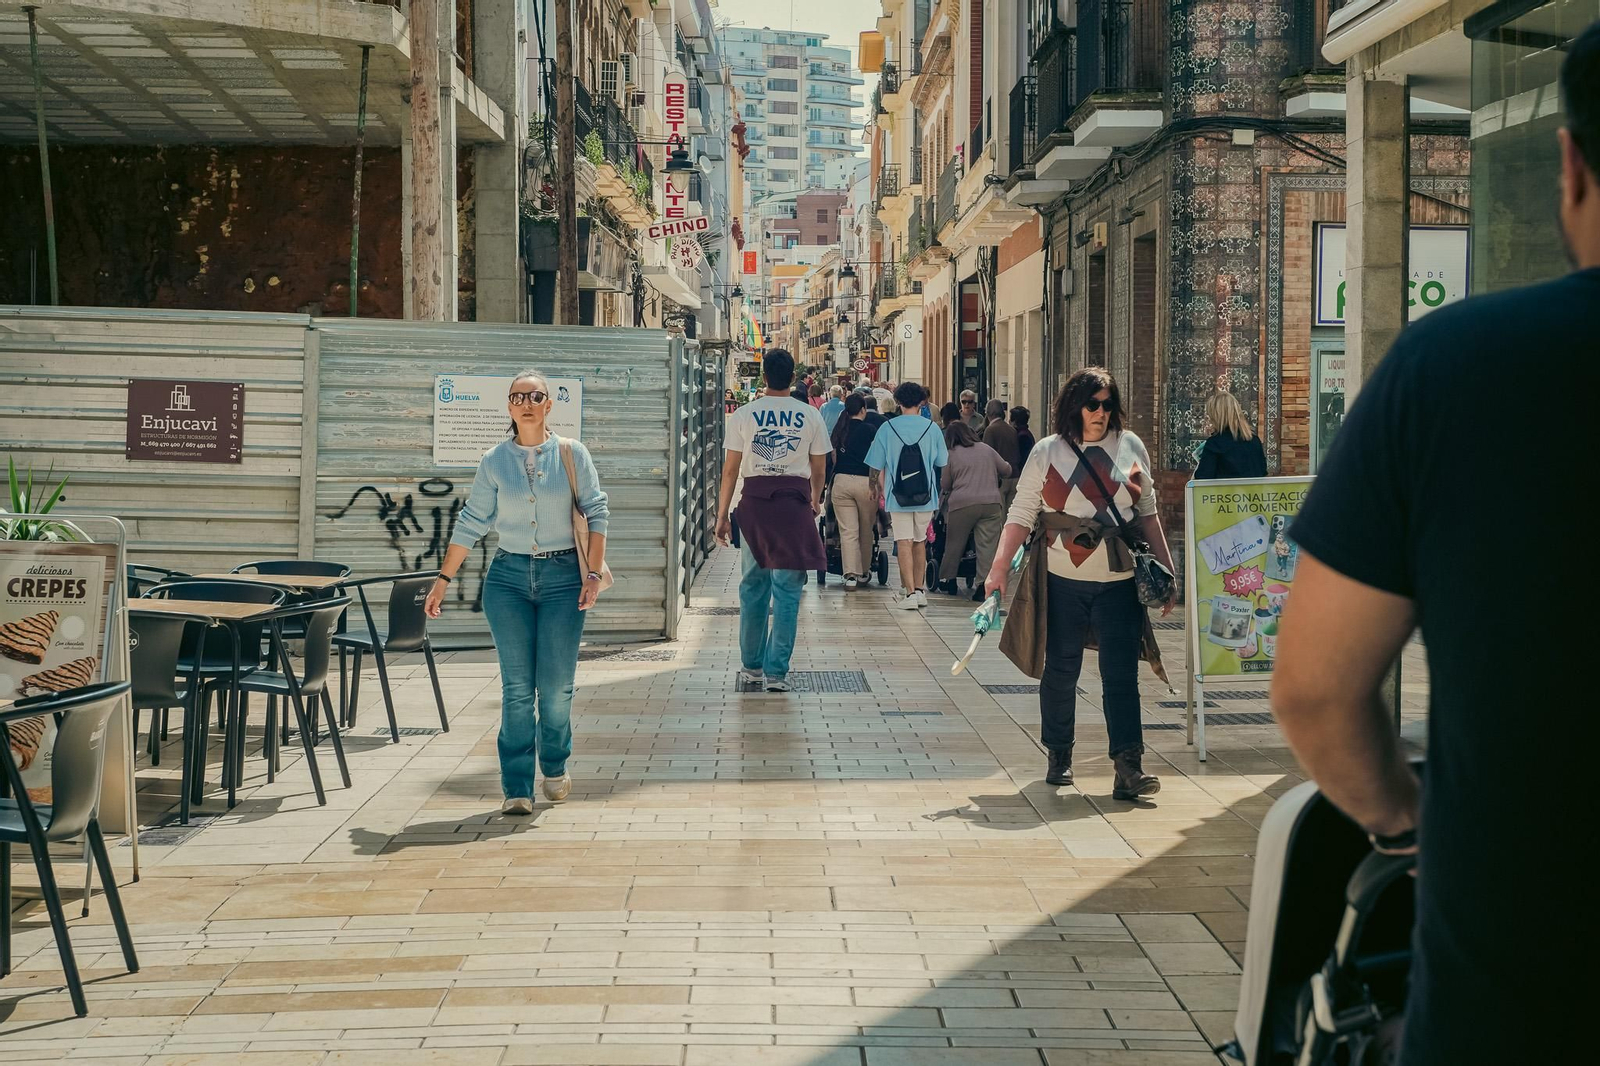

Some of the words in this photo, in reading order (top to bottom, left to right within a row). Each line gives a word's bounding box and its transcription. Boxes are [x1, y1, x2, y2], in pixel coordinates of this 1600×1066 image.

[648, 218, 708, 238] CHINO
[141, 415, 218, 433] Enjucavi
[752, 410, 805, 428] VANS
[1202, 489, 1307, 504] PERSONALIZACIÓ
[1218, 504, 1233, 513] AL
[1212, 539, 1256, 572] Martina
[26, 565, 72, 575] deliciosos
[7, 578, 86, 598] CREPES
[1230, 571, 1258, 590] 9,95€
